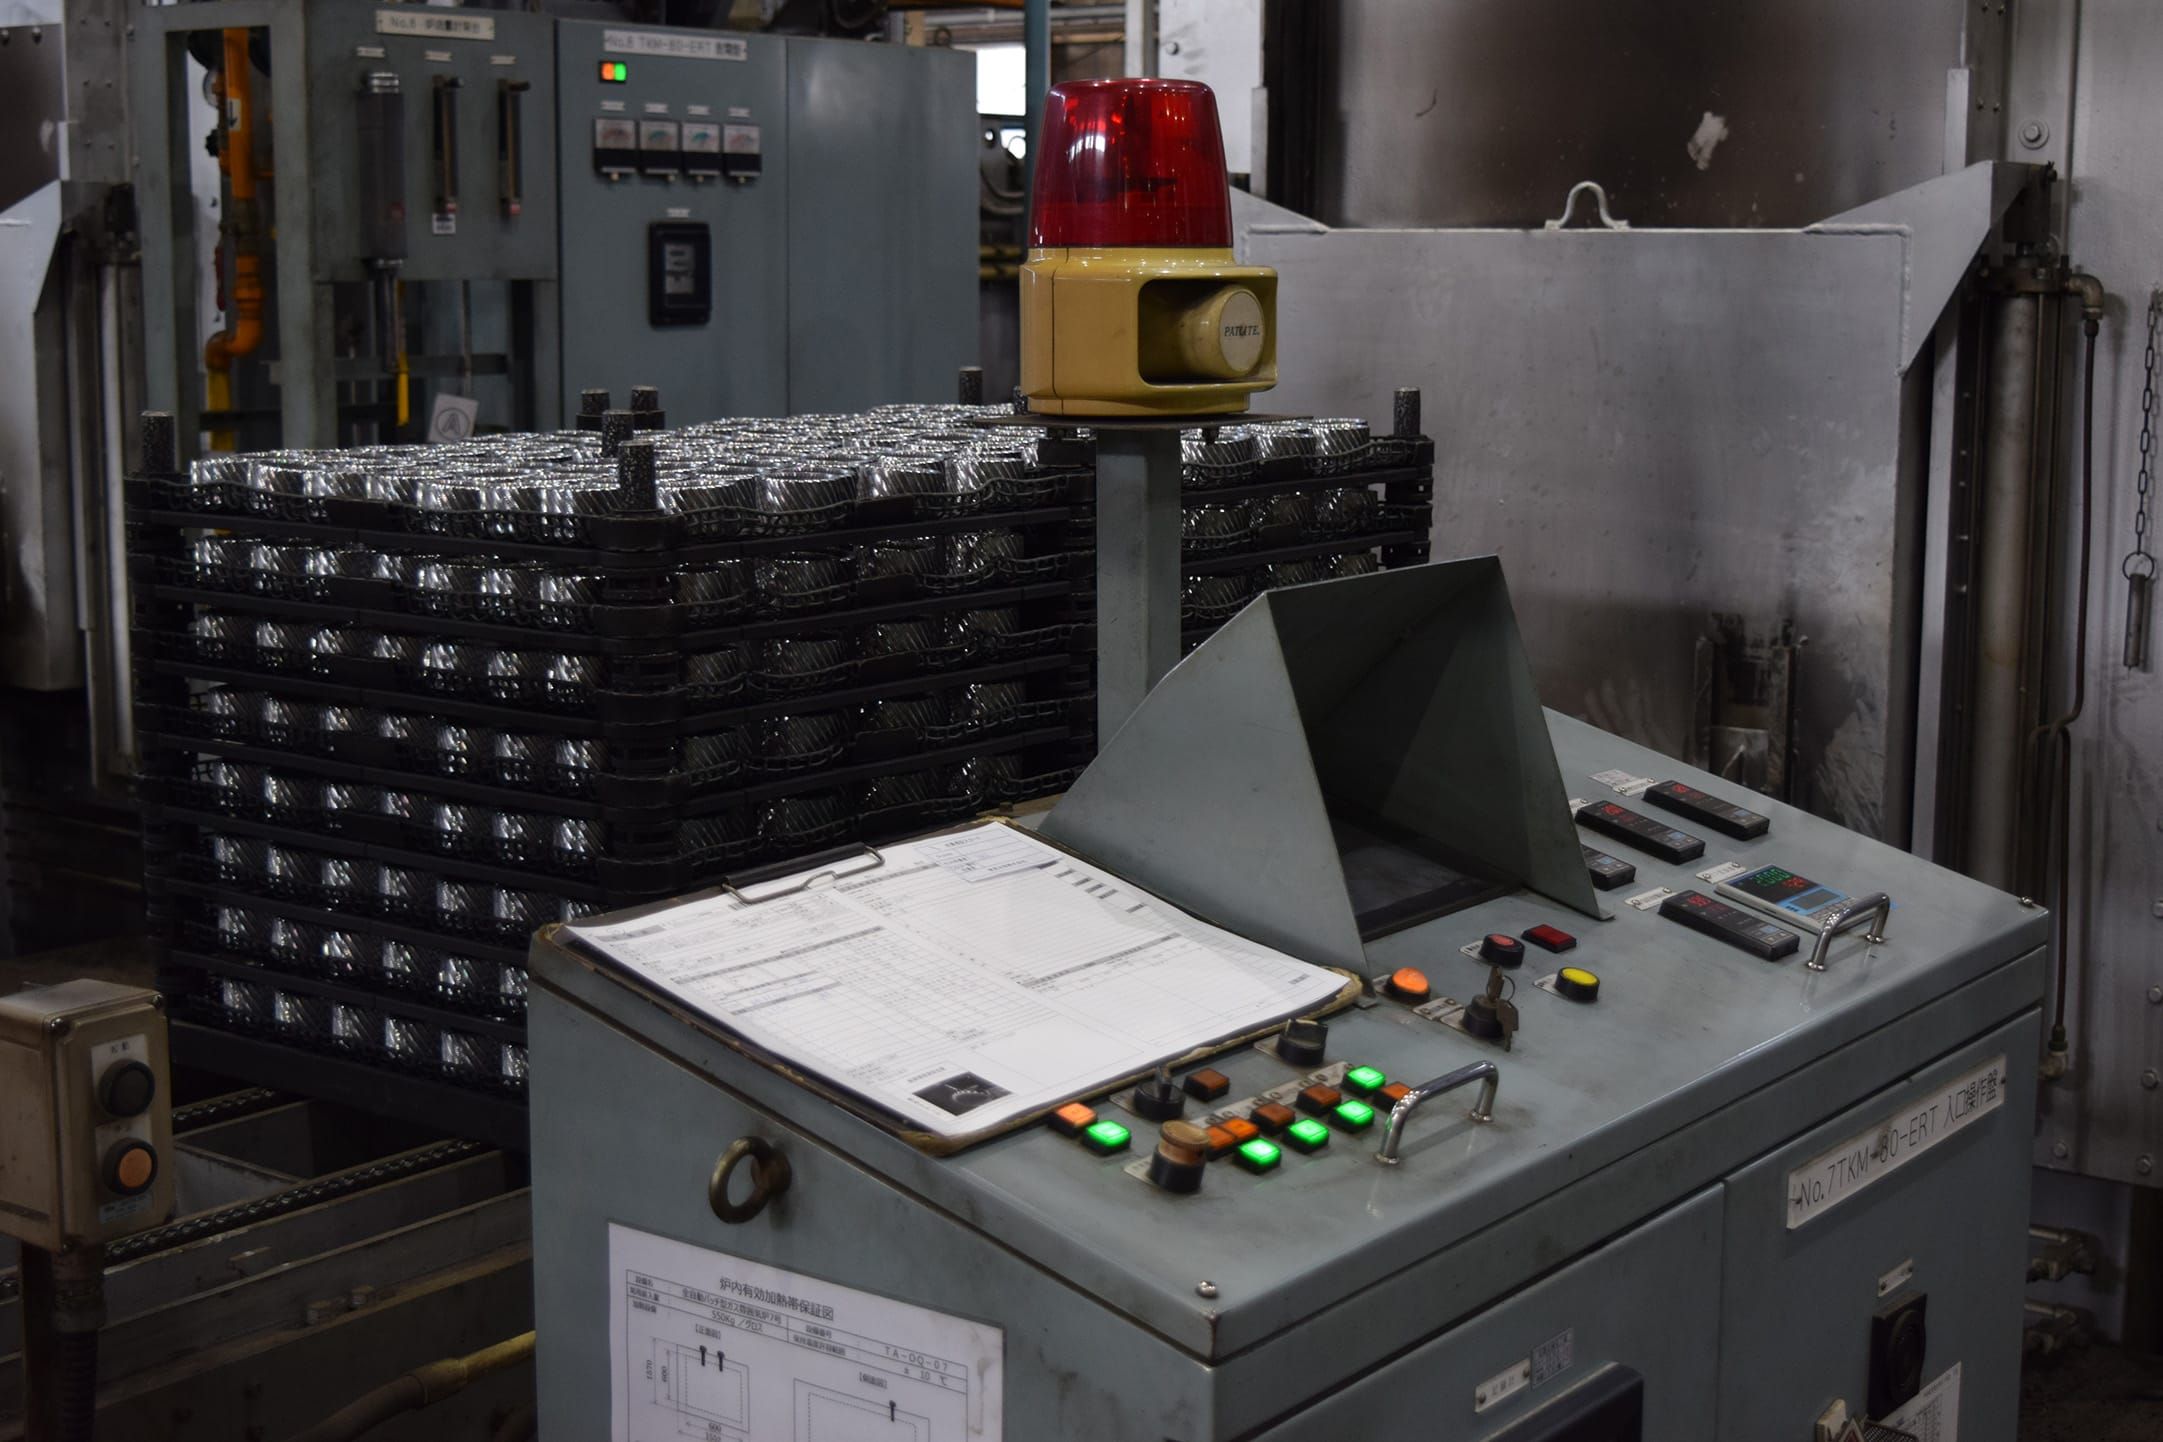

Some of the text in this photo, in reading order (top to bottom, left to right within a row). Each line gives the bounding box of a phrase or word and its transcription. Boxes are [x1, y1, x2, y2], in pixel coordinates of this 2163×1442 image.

[1943, 1067, 1998, 1129] 入口操作盤
[719, 1276, 834, 1321] 炉内有効加熱帯保証図
